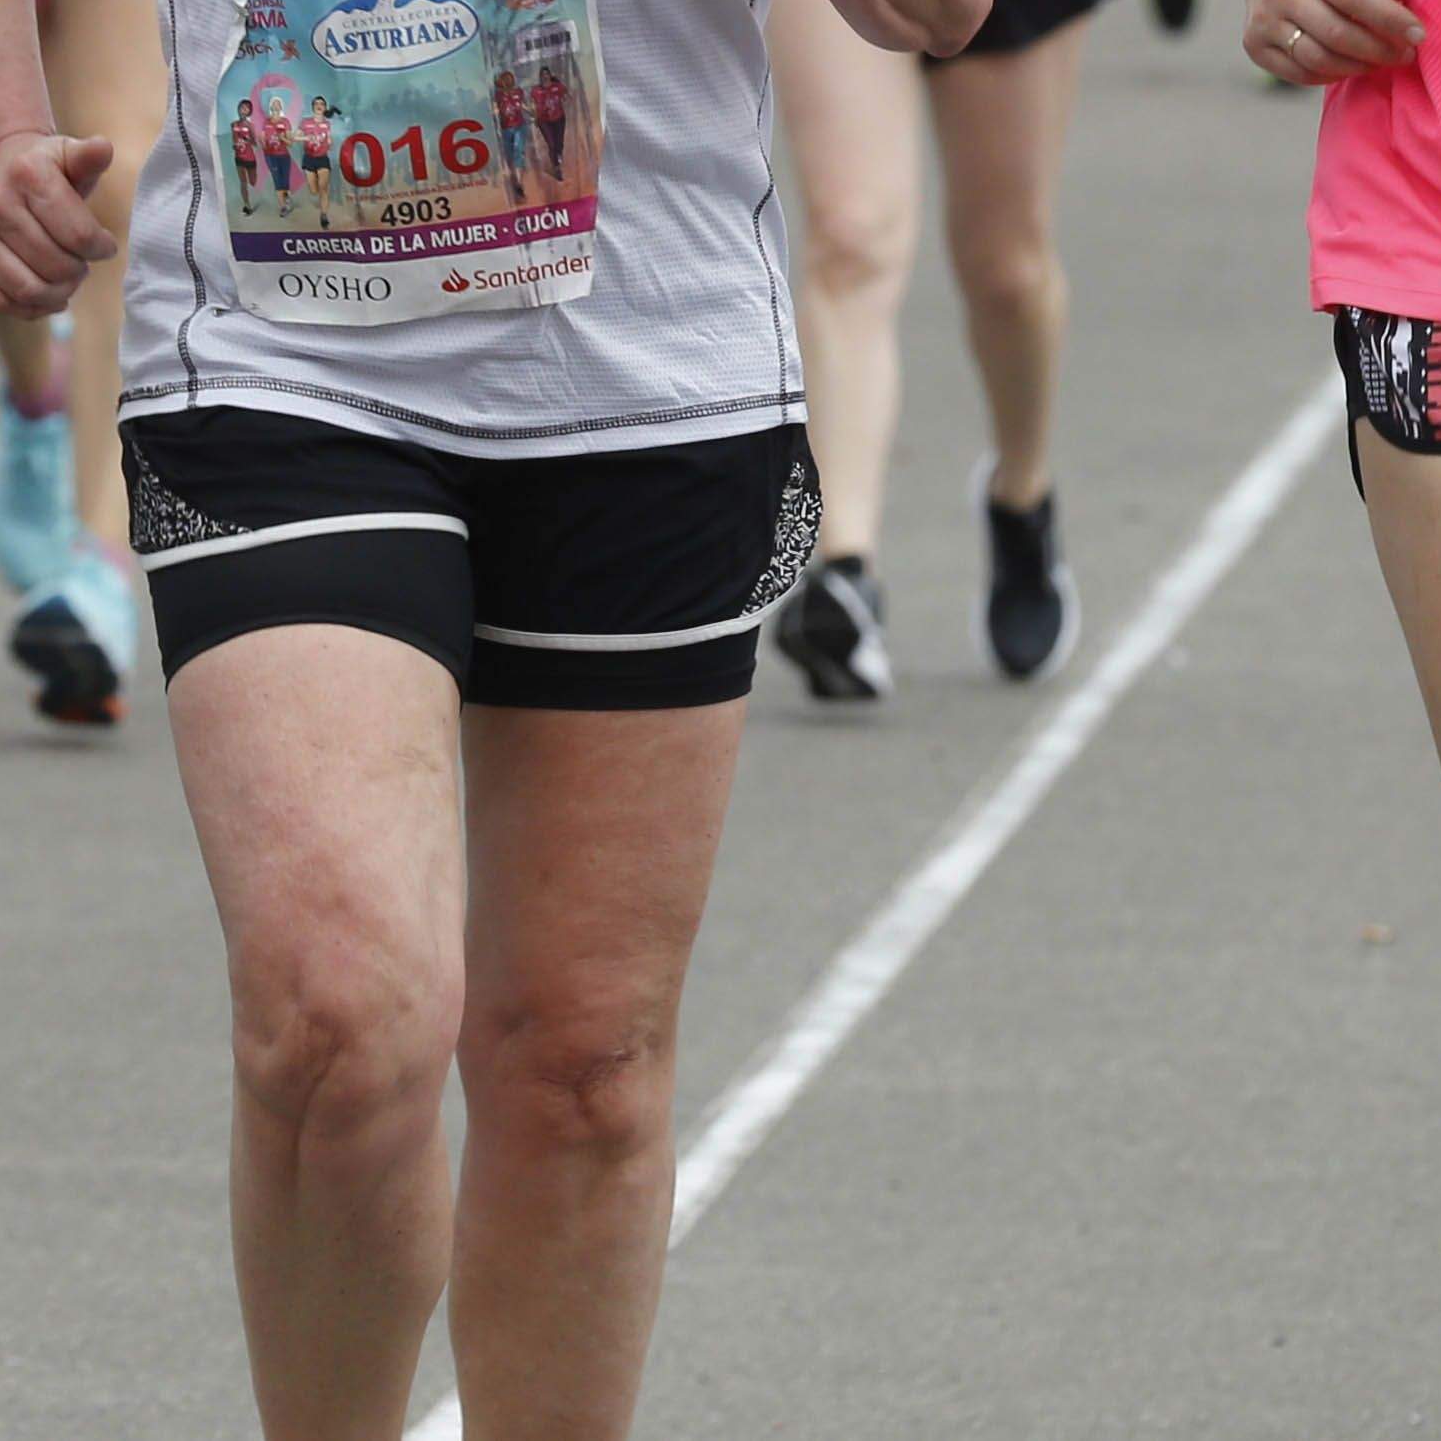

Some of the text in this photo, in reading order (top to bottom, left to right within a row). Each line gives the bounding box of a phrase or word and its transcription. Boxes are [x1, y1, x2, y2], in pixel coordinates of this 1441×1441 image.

[246, 9, 288, 30] UMA
[342, 6, 459, 29] CENTRAL LECHERA
[324, 18, 469, 57] ASTURIANA
[338, 118, 491, 188] 016
[380, 196, 452, 227] 4903
[282, 209, 571, 256] CARRERA DE LA MUJER GIJÓN
[278, 254, 593, 303] OYSHO Santander
